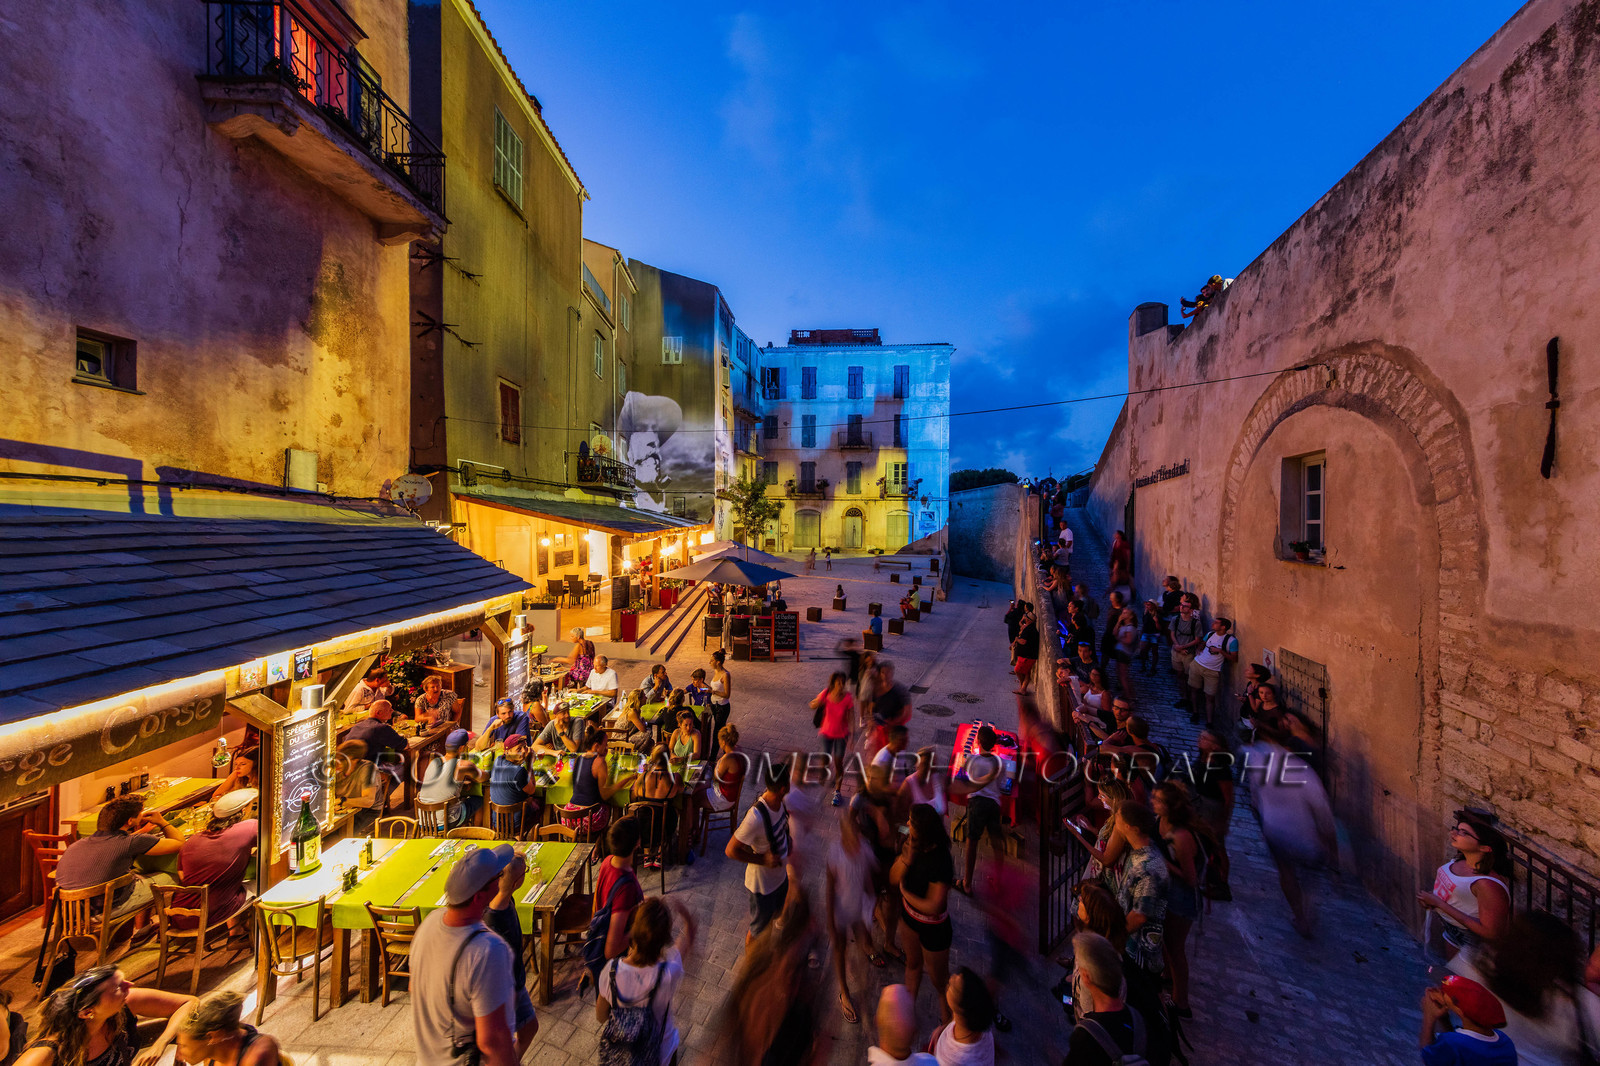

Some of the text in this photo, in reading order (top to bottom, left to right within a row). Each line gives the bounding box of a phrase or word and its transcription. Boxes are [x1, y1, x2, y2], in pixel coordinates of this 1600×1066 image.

[100, 698, 213, 755] Corse
[289, 728, 319, 745] DU CHEF
